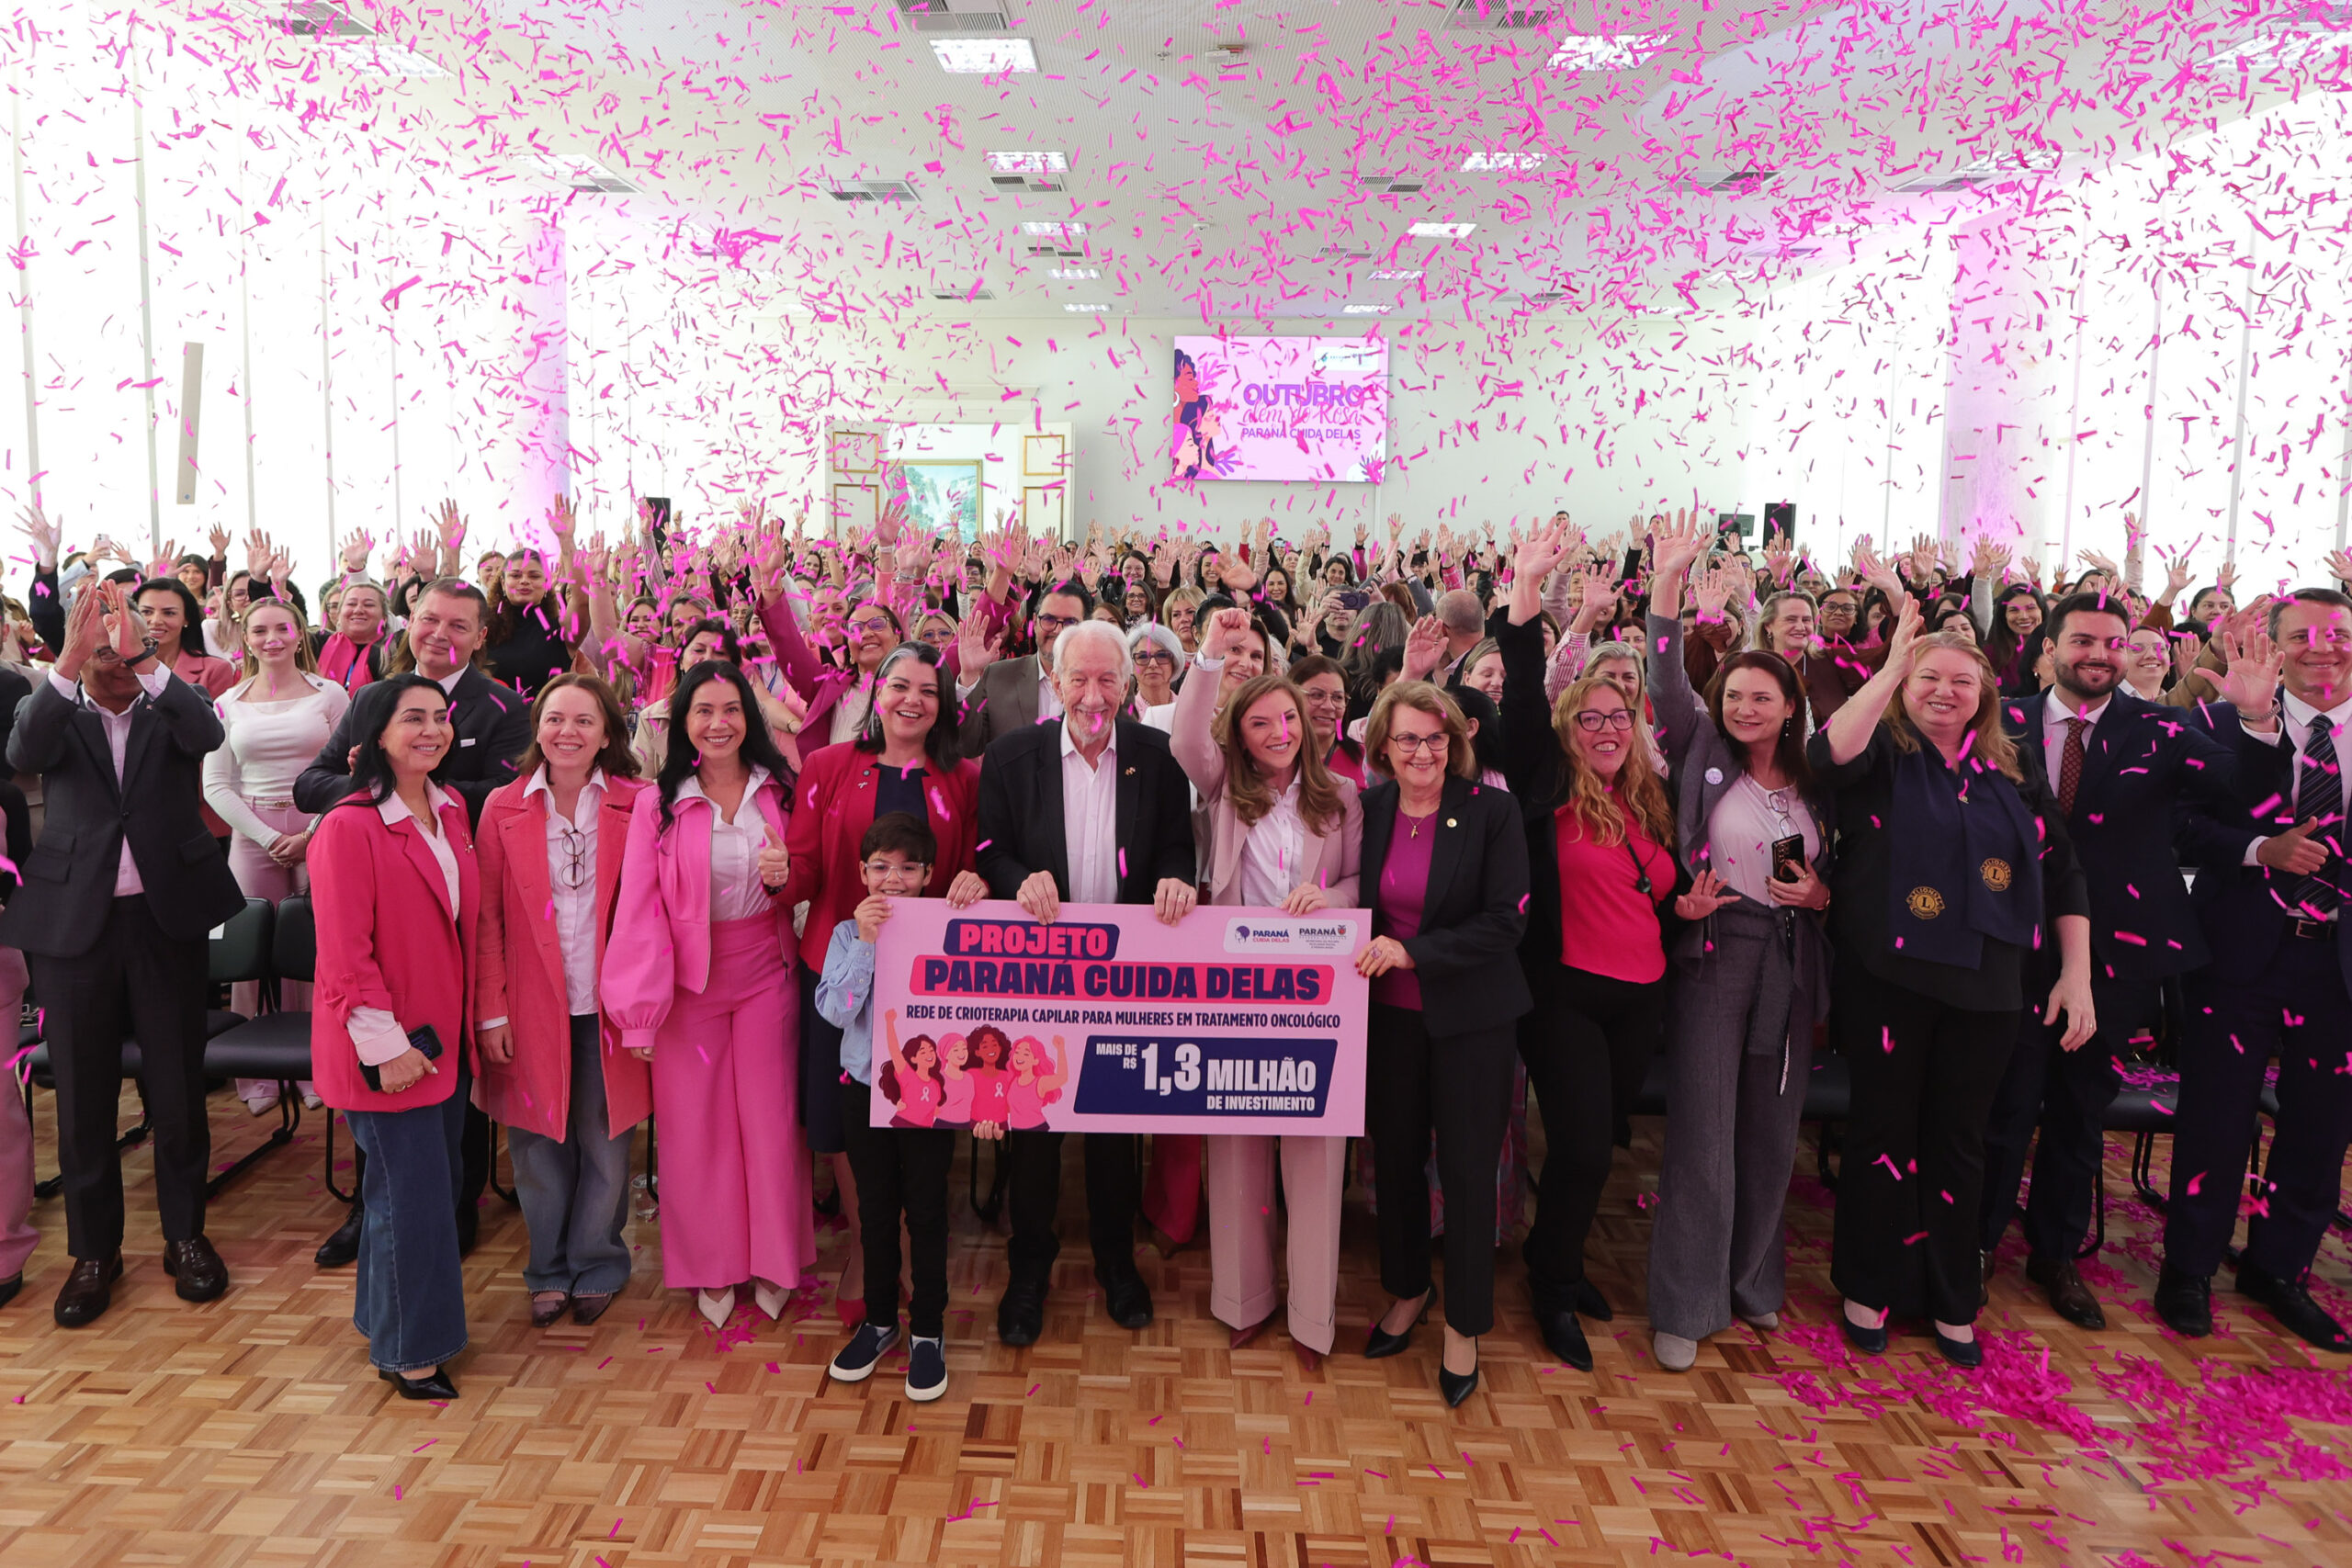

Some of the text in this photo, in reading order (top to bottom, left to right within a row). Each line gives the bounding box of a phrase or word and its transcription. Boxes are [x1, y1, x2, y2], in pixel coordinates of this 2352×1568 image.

[1243, 383, 1364, 407] OUTUBRO
[1326, 429, 1361, 439] DELAS
[1992, 868, 2000, 881] L
[1922, 897, 1930, 908] L
[1252, 929, 1289, 937] PARANÁ
[1299, 927, 1337, 935] PARANÁ
[959, 923, 1108, 957] PROJETO
[924, 959, 1320, 1000] PARANÁ CUIDA DELAS
[906, 1005, 1340, 1028] REDE DE CRIOTERAPIA CAPILAR PARA MULHERES EM TRATAMENTO ONCOLÓGICO
[1095, 1043, 1137, 1055] MAIS DE
[1123, 1057, 1137, 1070] R$
[1141, 1043, 1317, 1096] 1,3 MILHÃO
[1206, 1095, 1315, 1111] DE INVESTIMENTO
